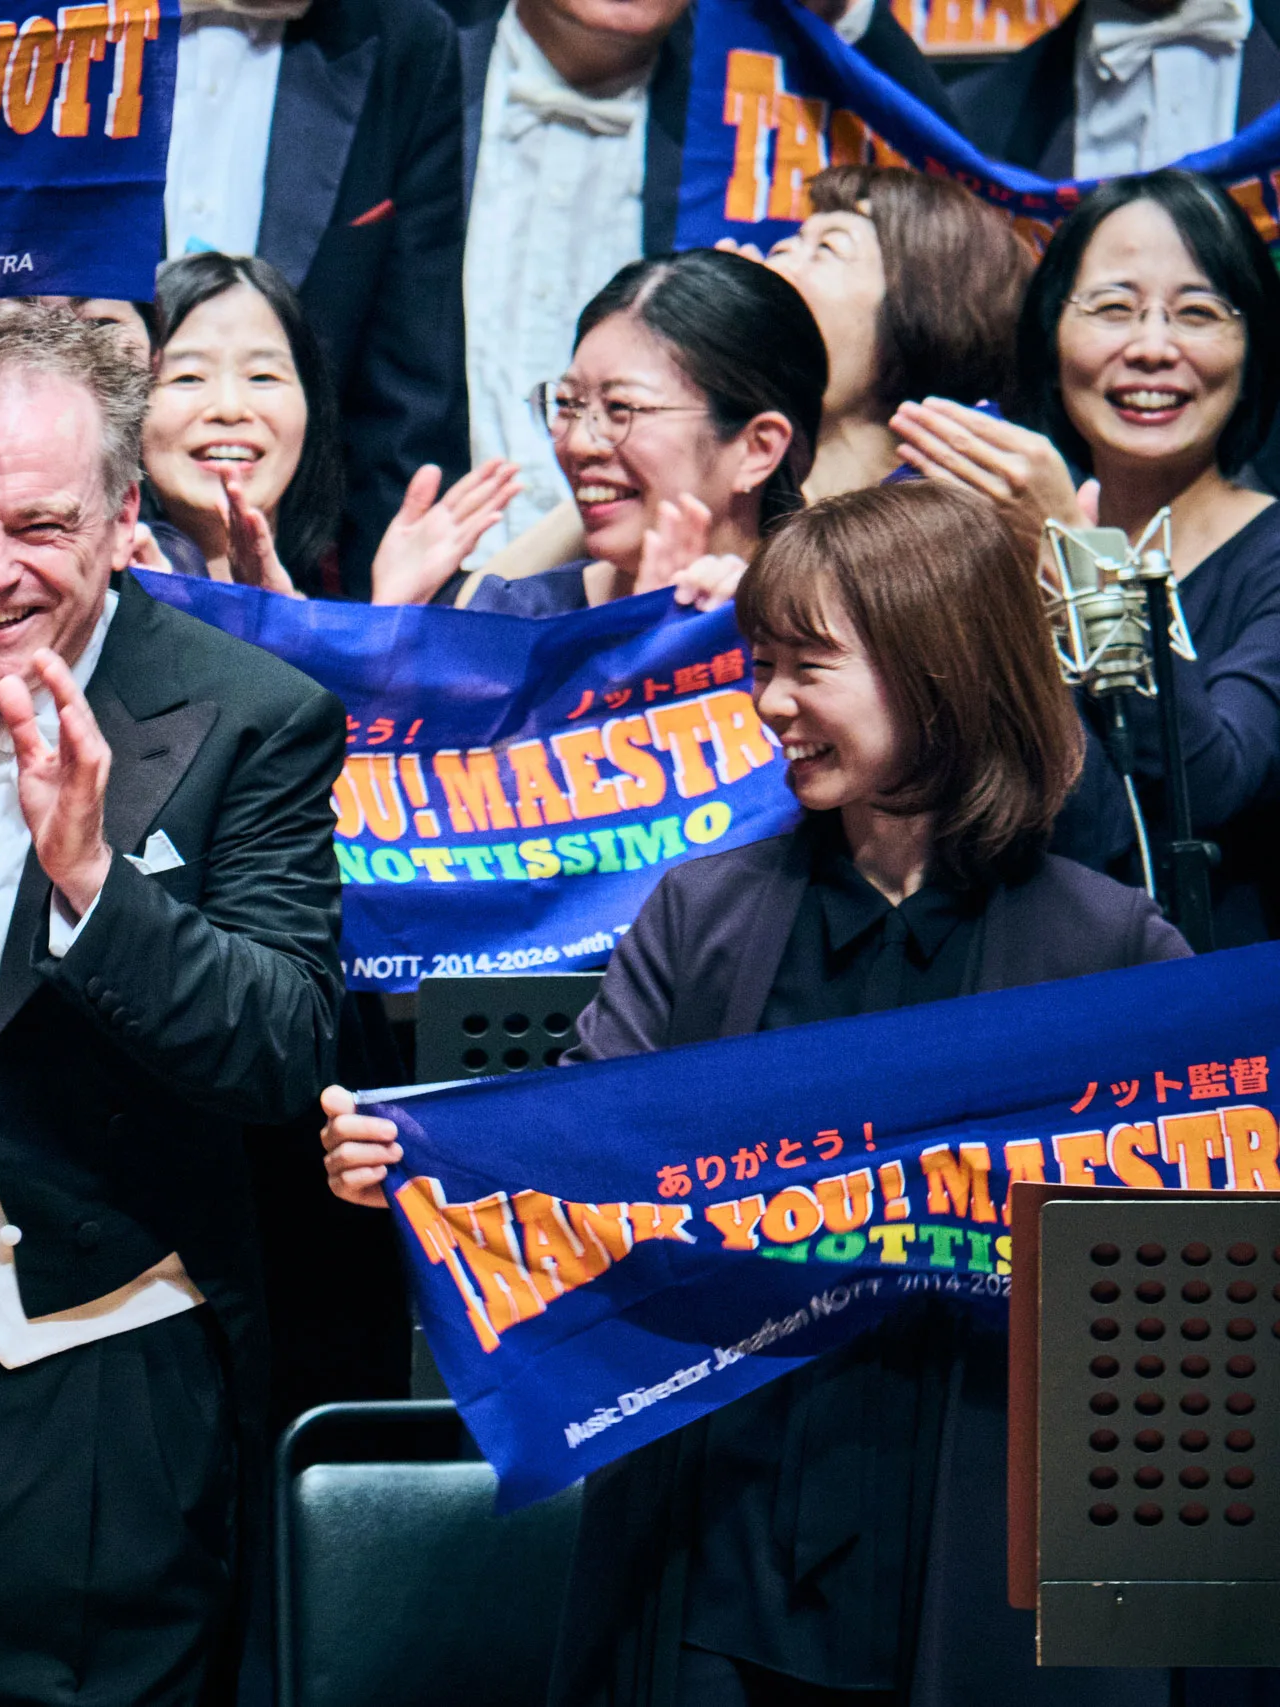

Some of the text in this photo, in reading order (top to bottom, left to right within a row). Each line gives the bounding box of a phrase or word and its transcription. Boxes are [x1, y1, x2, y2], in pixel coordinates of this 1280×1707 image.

[566, 647, 746, 720] ノット監督
[329, 688, 783, 842] OU! MAESTR
[332, 801, 732, 885] NOTTISSIMO
[431, 945, 560, 977] 2014-2026
[562, 931, 615, 958] with
[1069, 1055, 1270, 1115] ノット監督
[394, 1103, 1280, 1354] THANK YOU! MAESTR
[563, 1406, 623, 1449] Music
[617, 1358, 712, 1418] Director
